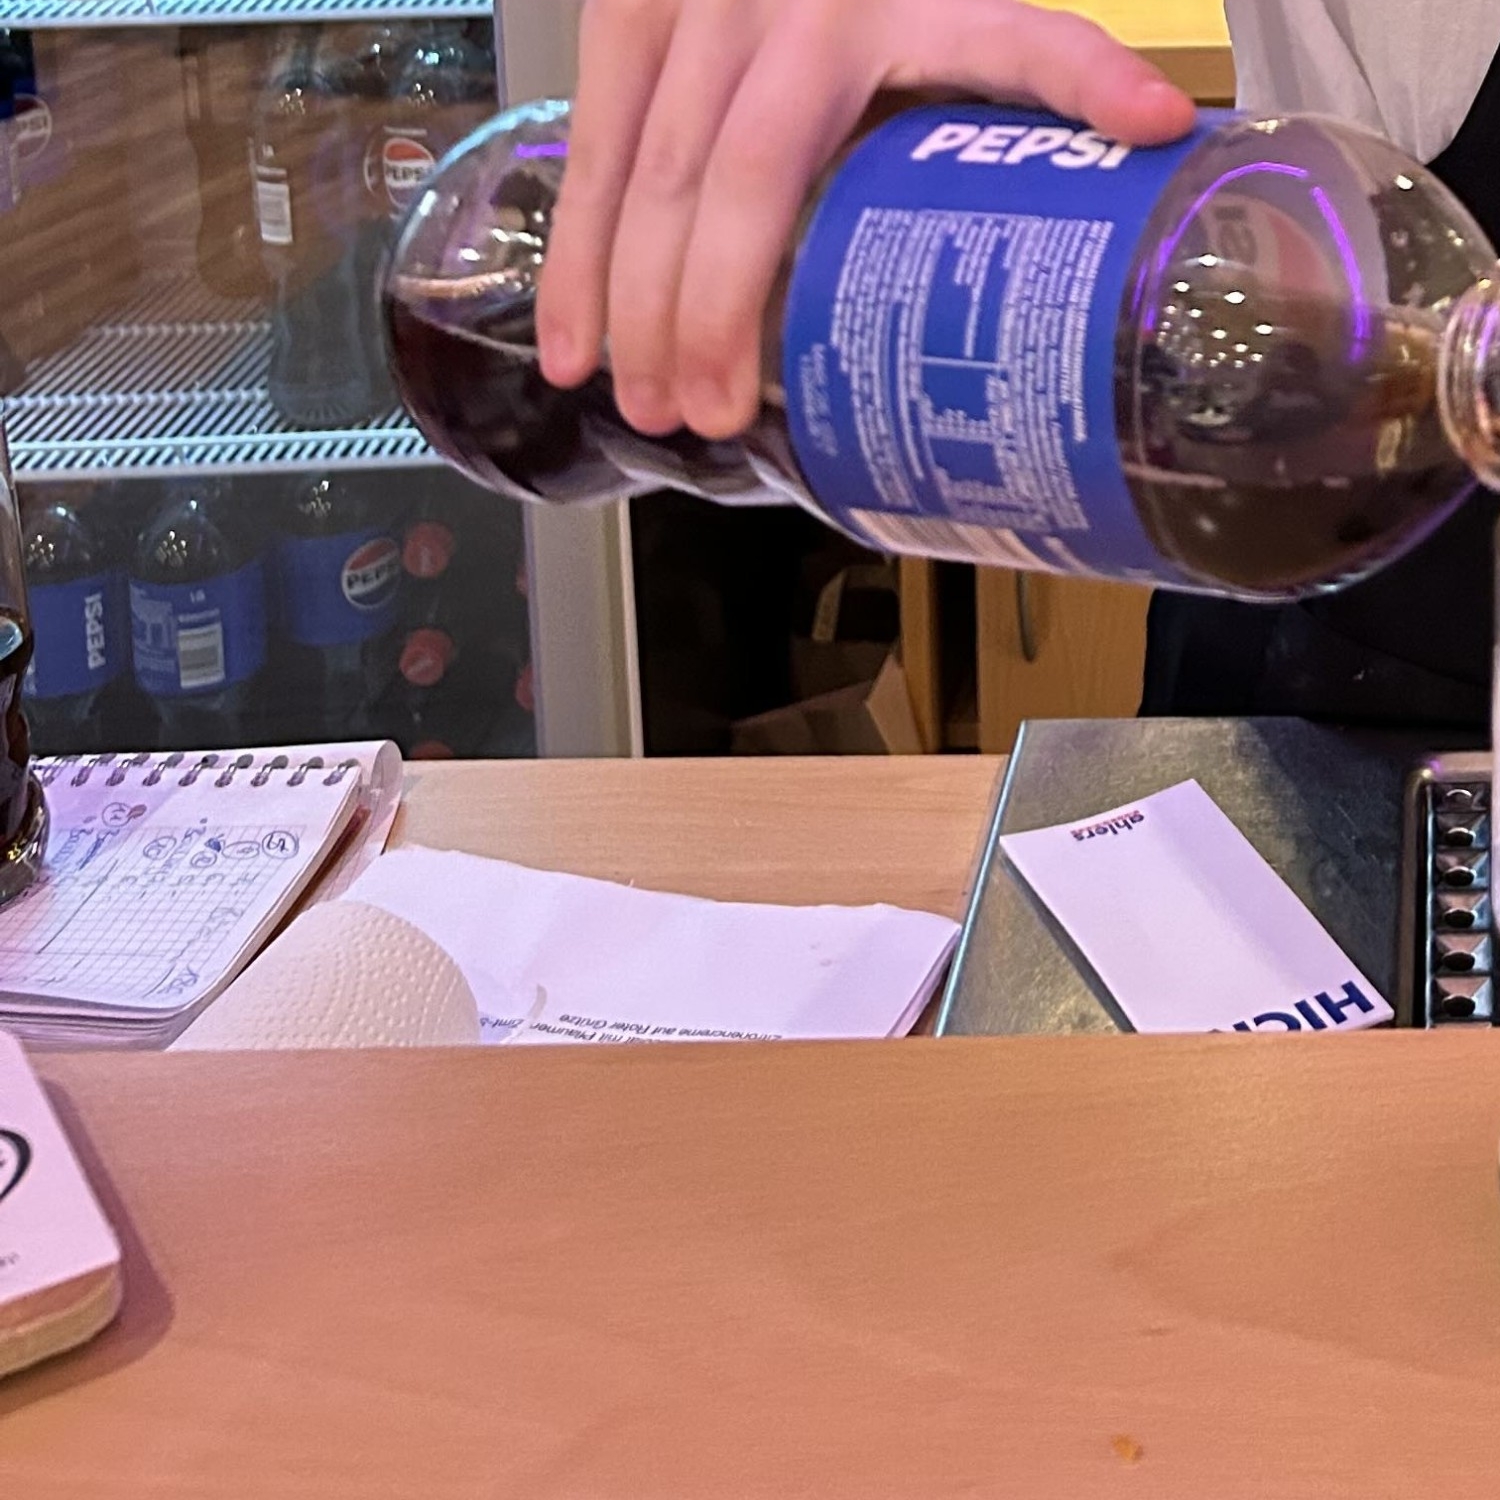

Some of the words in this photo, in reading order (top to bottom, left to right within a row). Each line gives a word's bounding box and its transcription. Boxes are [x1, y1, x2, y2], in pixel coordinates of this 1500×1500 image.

[910, 122, 1133, 170] PEPSI
[85, 592, 106, 670] PEPSI
[1072, 812, 1145, 841] ahlers
[559, 1013, 607, 1029] Grütze
[609, 1021, 650, 1034] Roter
[651, 1026, 676, 1036] auf
